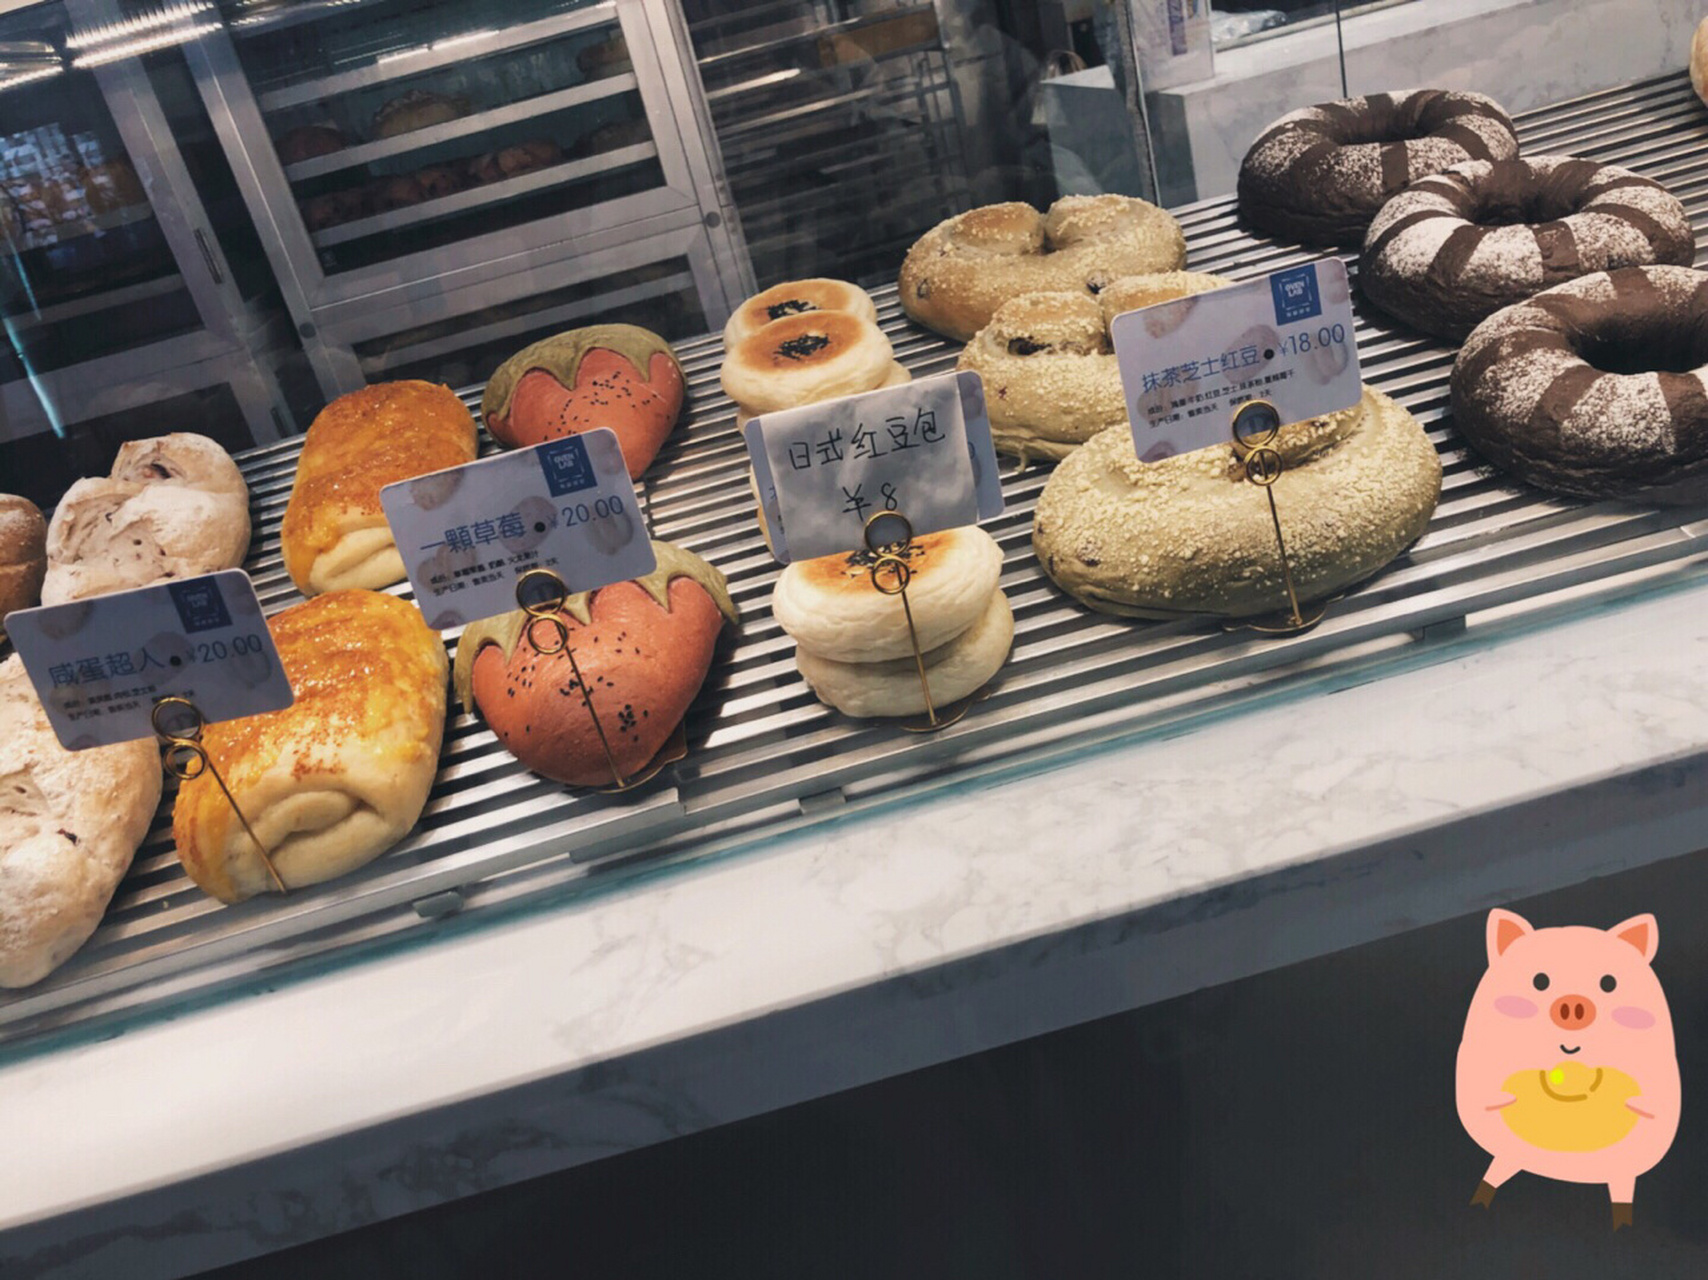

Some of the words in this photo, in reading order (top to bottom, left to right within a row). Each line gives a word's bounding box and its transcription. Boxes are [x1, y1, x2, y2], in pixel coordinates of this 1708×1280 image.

[1142, 344, 1260, 394] 抹茶芝士红豆
[788, 408, 945, 470] 日式红豆包
[48, 646, 166, 689] 咸蛋超人
